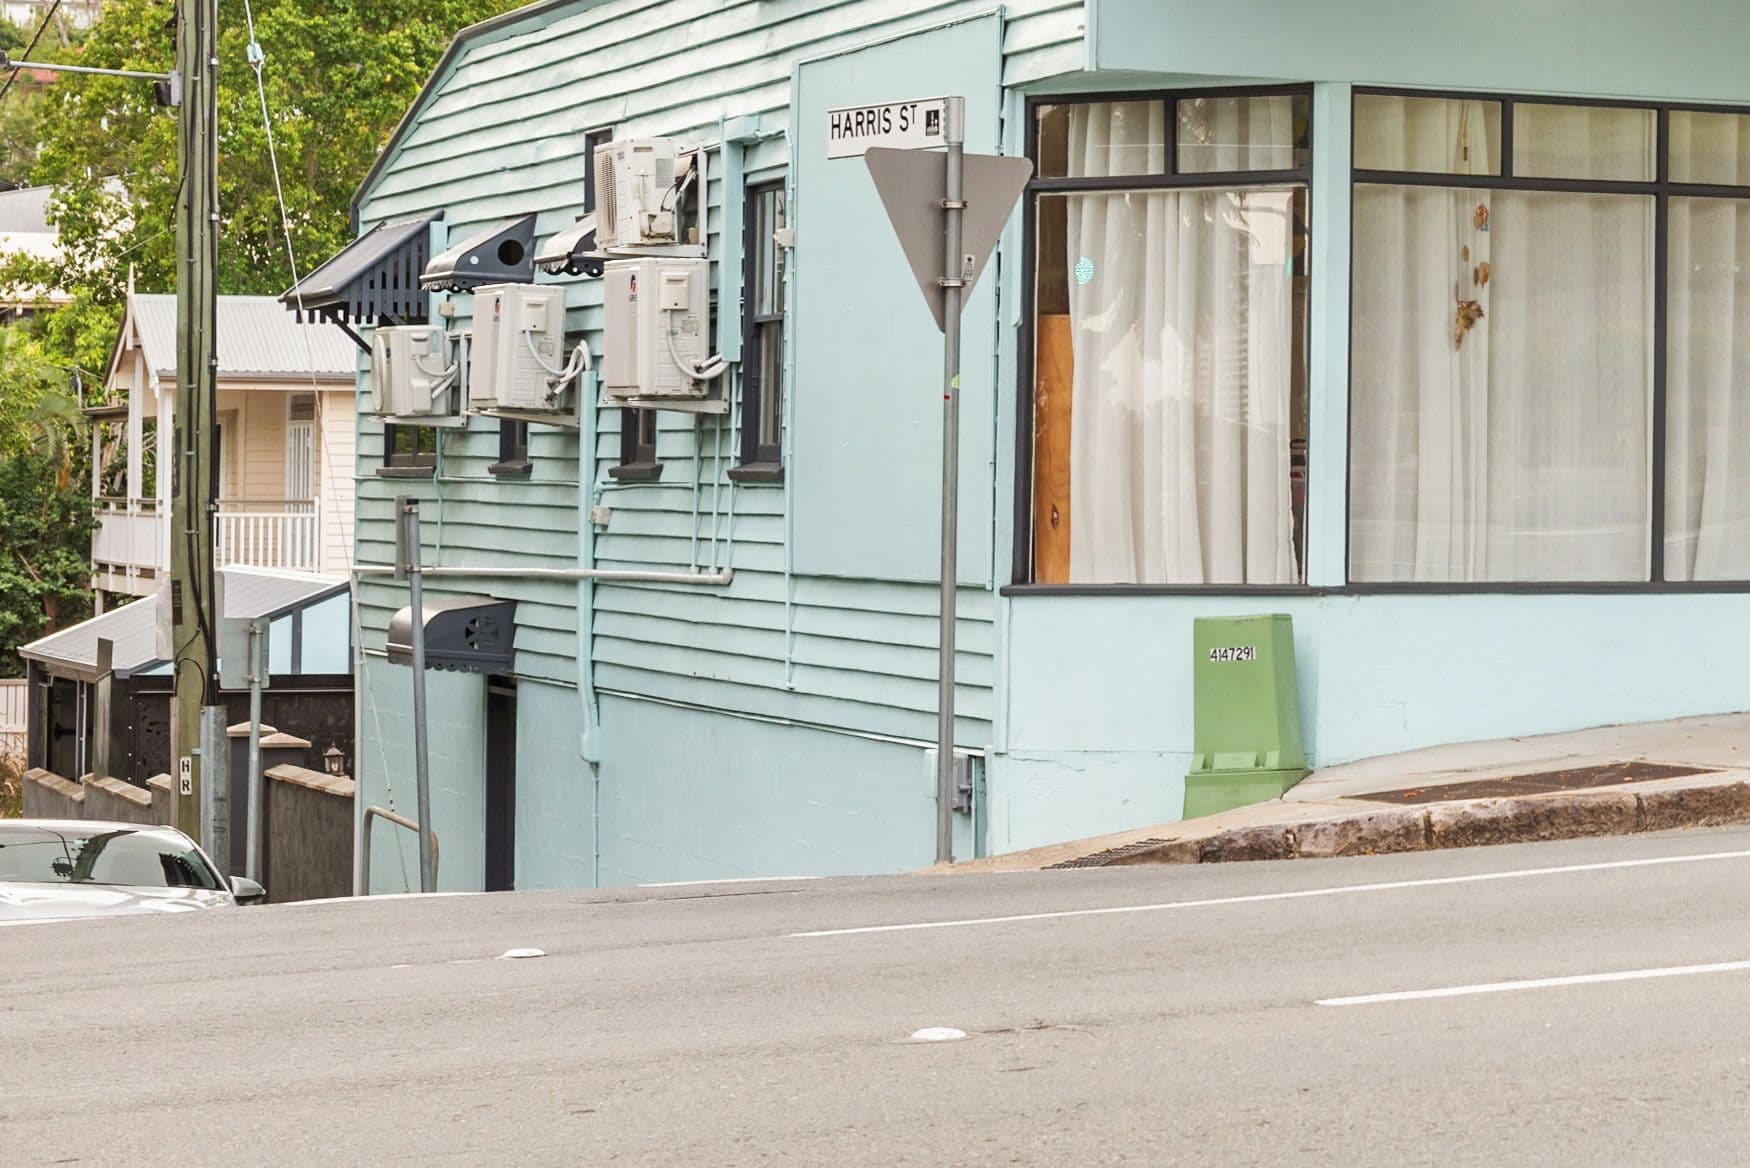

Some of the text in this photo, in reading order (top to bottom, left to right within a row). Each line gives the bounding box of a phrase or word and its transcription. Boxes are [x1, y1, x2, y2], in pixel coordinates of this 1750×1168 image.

[830, 104, 918, 140] HARRIS ST
[1209, 646, 1254, 661] 4147291
